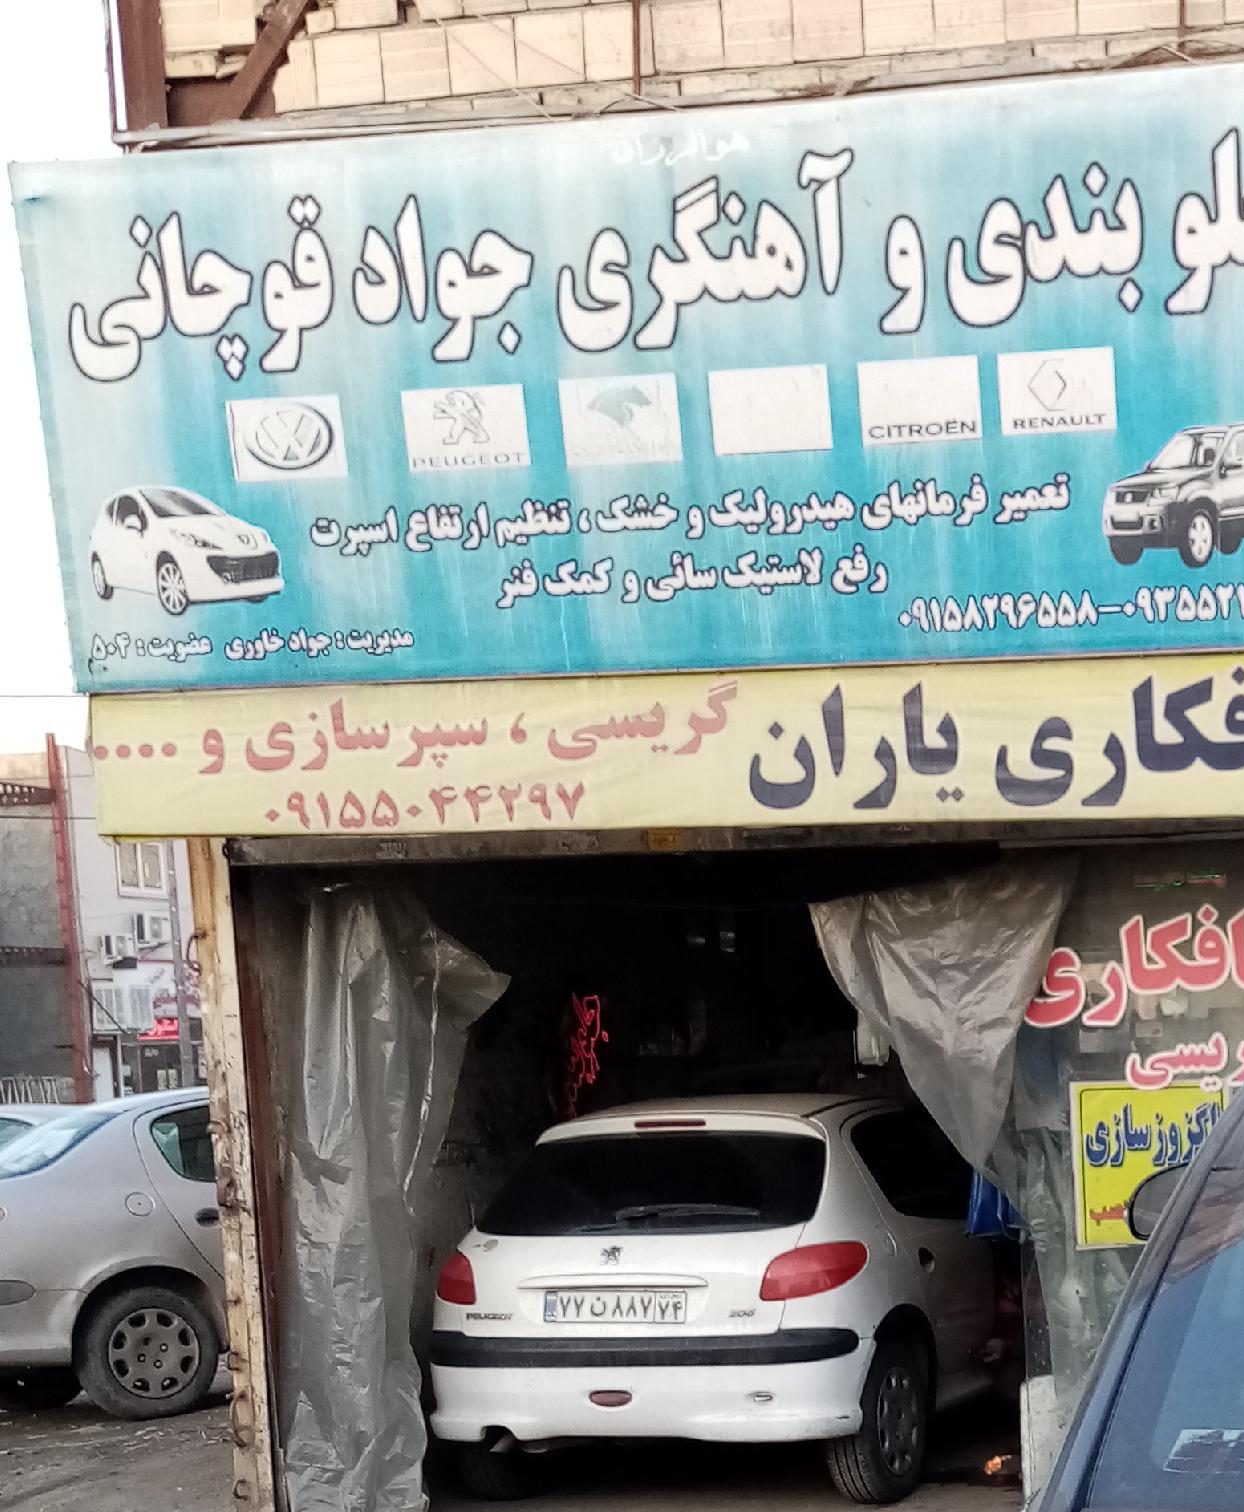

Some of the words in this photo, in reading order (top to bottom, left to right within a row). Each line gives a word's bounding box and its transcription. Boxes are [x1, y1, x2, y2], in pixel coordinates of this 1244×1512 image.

[556, 147, 854, 353] آهنگری
[945, 162, 1145, 328] بندی
[68, 195, 336, 383] قوچانی
[352, 193, 533, 363] جواد
[879, 214, 926, 335] و
[868, 419, 977, 440] CITROËN
[1012, 413, 1107, 431] RENAULT
[412, 451, 526, 469] PEUGEOT
[494, 498, 571, 548] تنظیم
[595, 493, 679, 533] خشک
[685, 504, 704, 540] و
[708, 486, 856, 536] هیدرولیک
[861, 473, 988, 531] فرمانهای
[993, 473, 1071, 525] تعمیر
[310, 506, 399, 556] اسپرت
[404, 501, 490, 552] ارتفاع
[496, 557, 539, 609] فنر
[542, 556, 613, 597] کمک
[621, 568, 641, 603] و
[722, 546, 823, 595] لاستیک
[831, 543, 888, 594] رفع
[547, 678, 739, 756] گریسی
[199, 728, 225, 773] و
[748, 682, 964, 811] یاران
[265, 780, 586, 829] ۰۹۱۵۵۰۴۴۲۹۷
[559, 1294, 586, 1319] ۷۷
[611, 1294, 653, 1319] ۸۸۷
